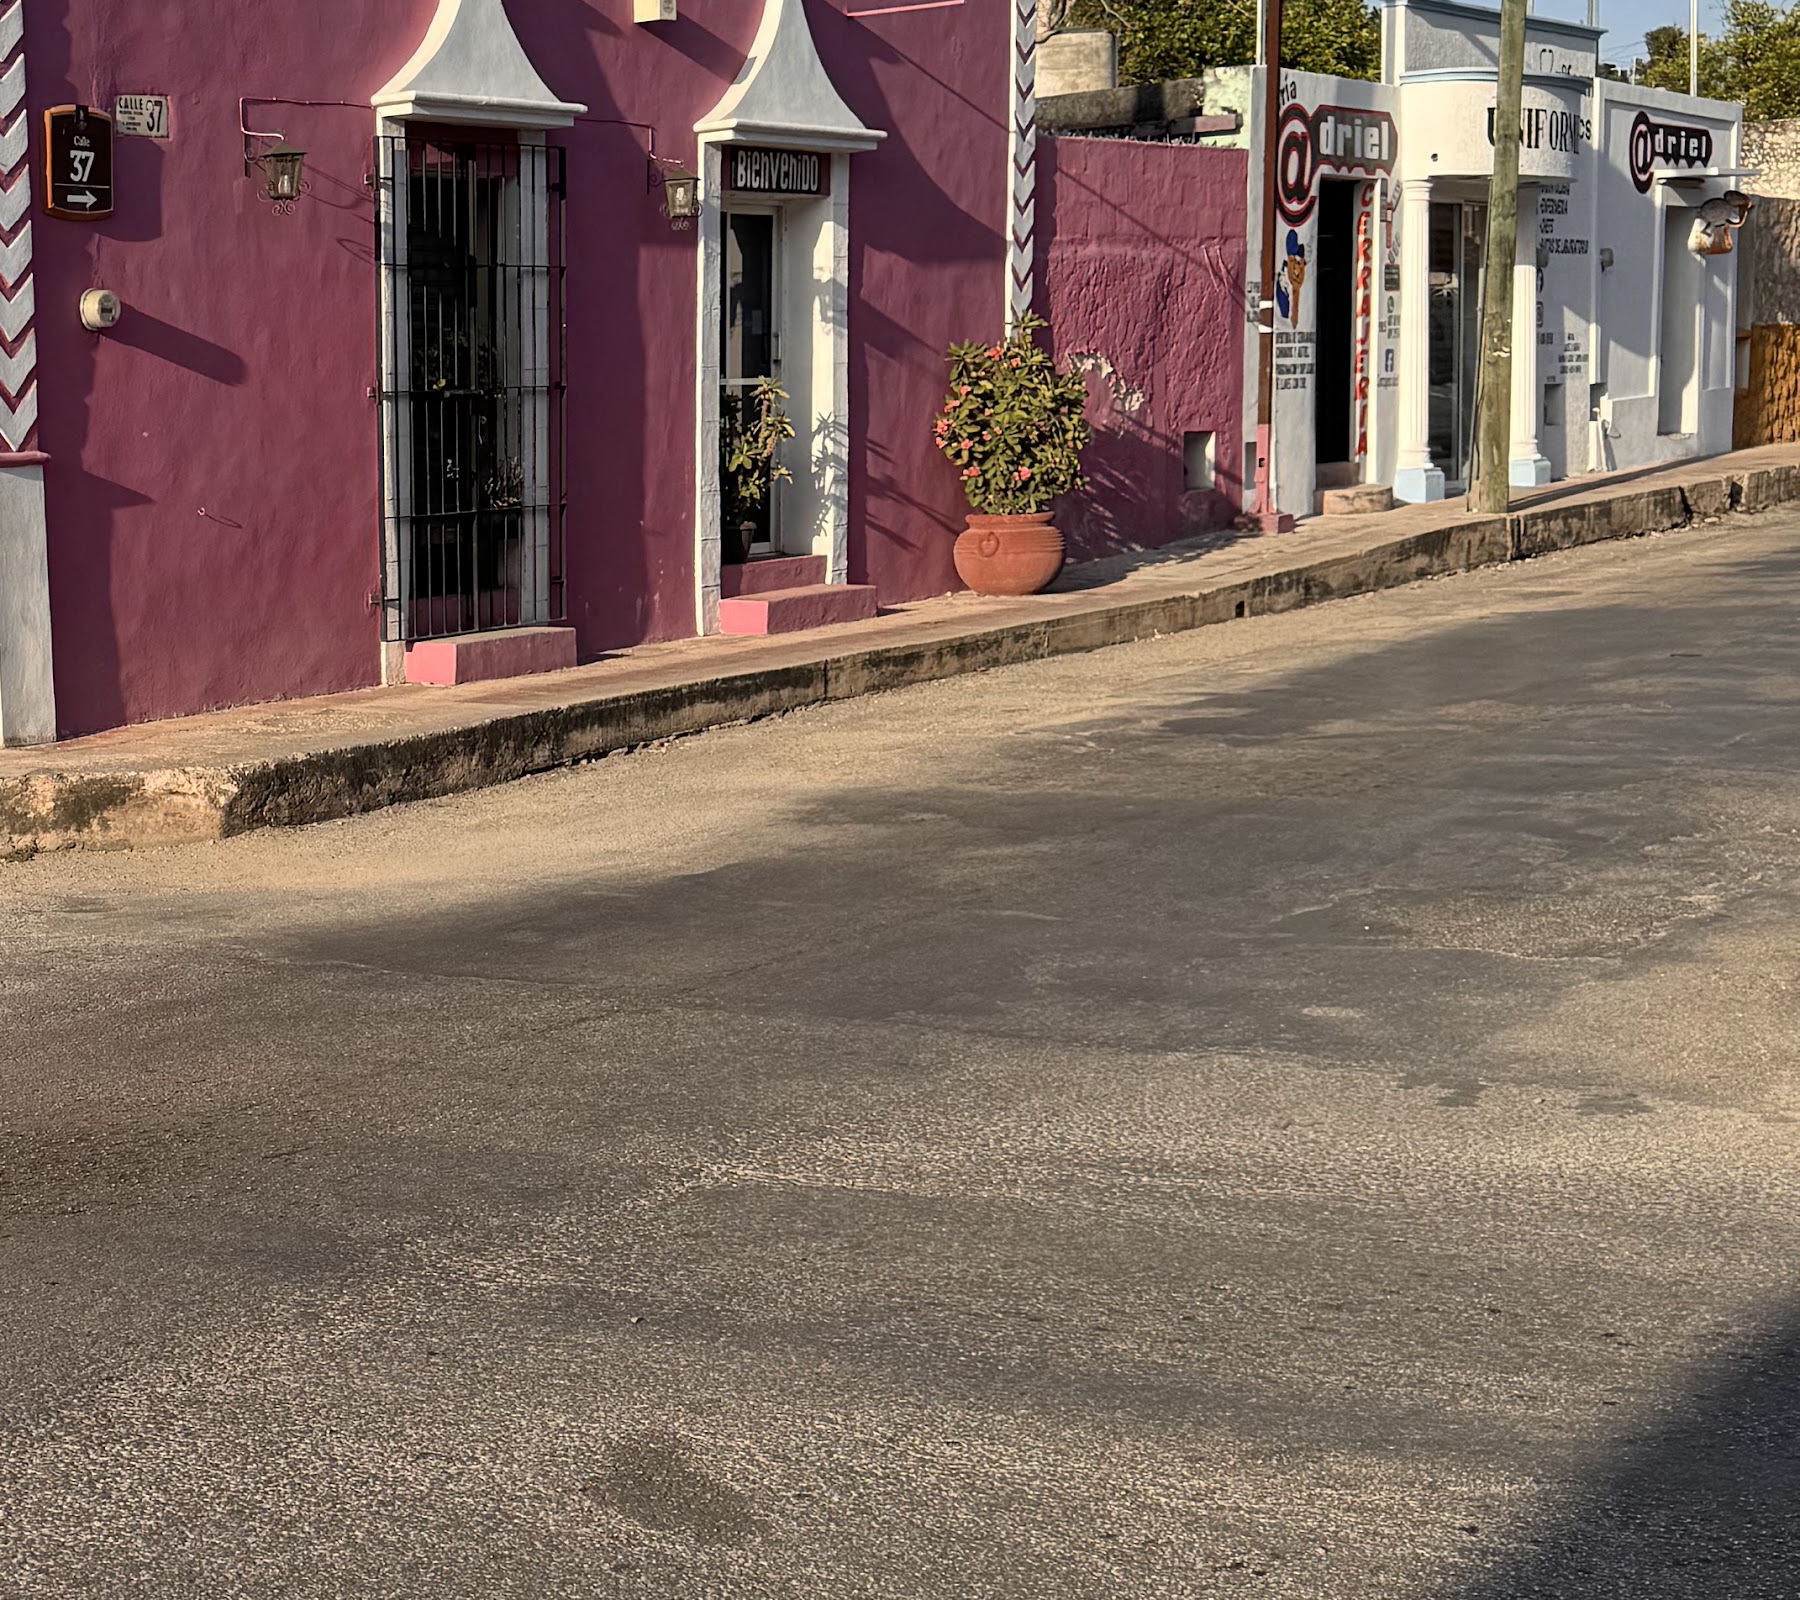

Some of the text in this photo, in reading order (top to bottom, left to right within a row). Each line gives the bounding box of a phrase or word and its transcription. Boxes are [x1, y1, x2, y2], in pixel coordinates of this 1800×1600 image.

[119, 96, 143, 111] CALLE
[146, 99, 163, 133] 37
[73, 135, 91, 147] Calle
[69, 149, 95, 183] 37
